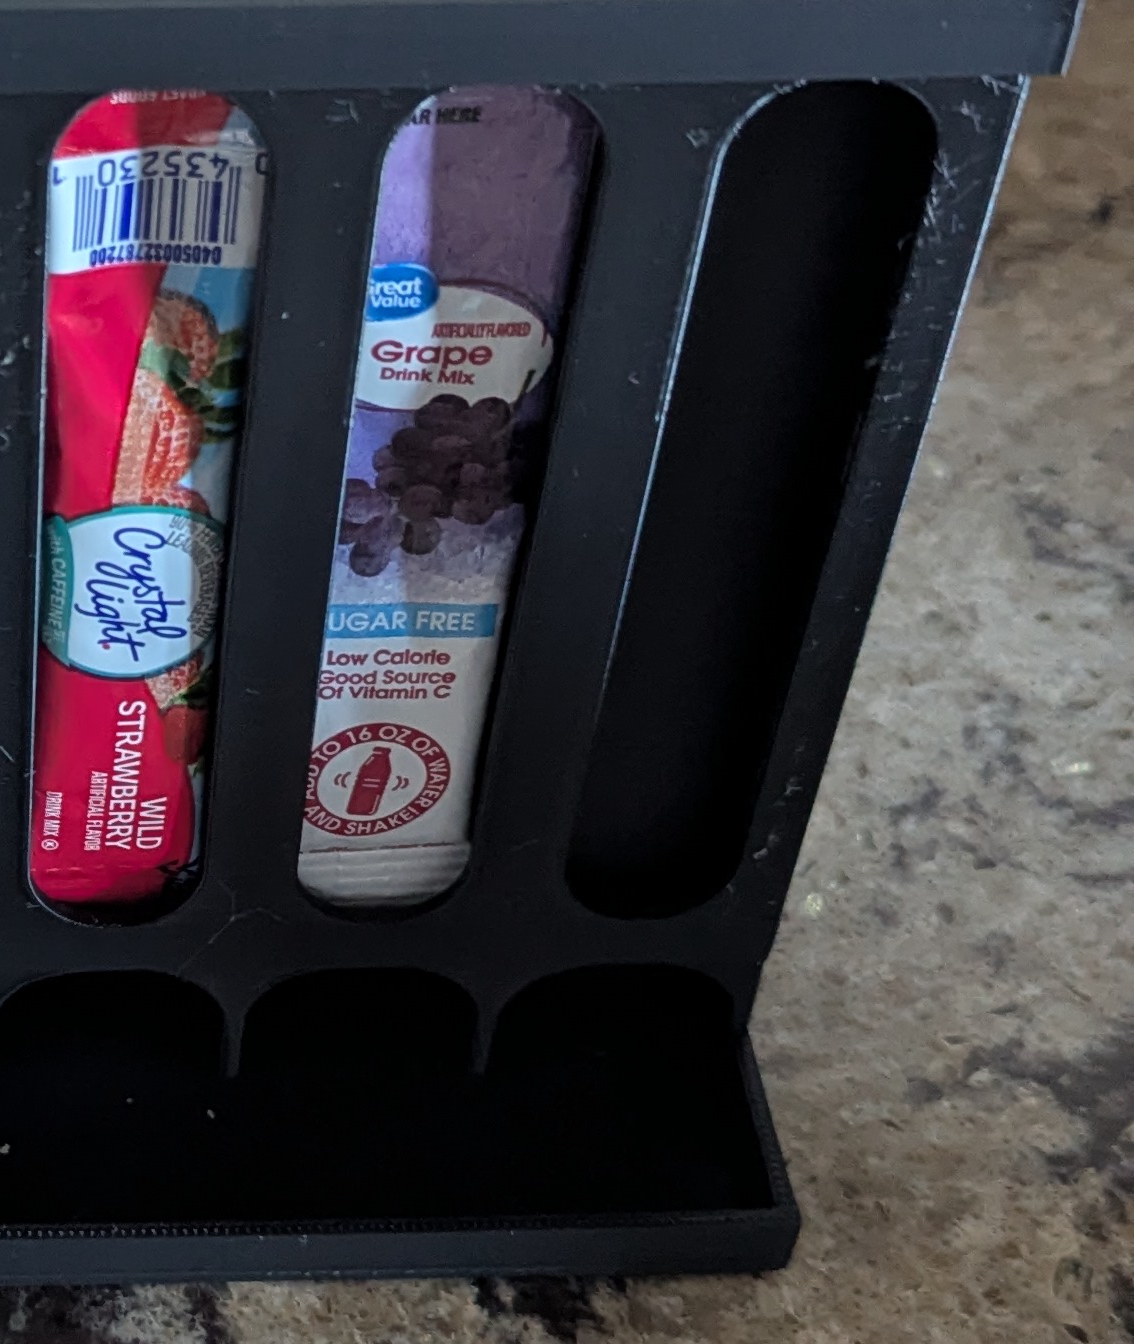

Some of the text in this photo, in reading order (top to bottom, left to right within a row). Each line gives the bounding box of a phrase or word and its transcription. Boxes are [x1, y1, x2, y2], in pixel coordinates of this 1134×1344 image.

[98, 151, 230, 187] 435230
[371, 295, 421, 308] Value
[370, 340, 493, 369] Grape
[379, 366, 475, 386] Drink Mix
[114, 527, 187, 640] Crystal
[74, 560, 145, 662] Light
[328, 610, 475, 633] UGAR FREE
[326, 649, 451, 666] Low Calorie
[319, 670, 456, 685] Good Source
[318, 685, 451, 700] Of Vitamin C
[347, 727, 371, 744] 16
[379, 725, 412, 744] OZ
[312, 741, 341, 762] TO
[411, 737, 440, 757] OF
[105, 700, 146, 850] STRAWBERRY
[415, 758, 448, 808] WATER
[44, 791, 63, 818] DRINK
[84, 771, 108, 851] ARTIFICIAL FLAVOR
[43, 819, 61, 836] MIX
[135, 797, 168, 849] WILD
[304, 805, 341, 831] AND
